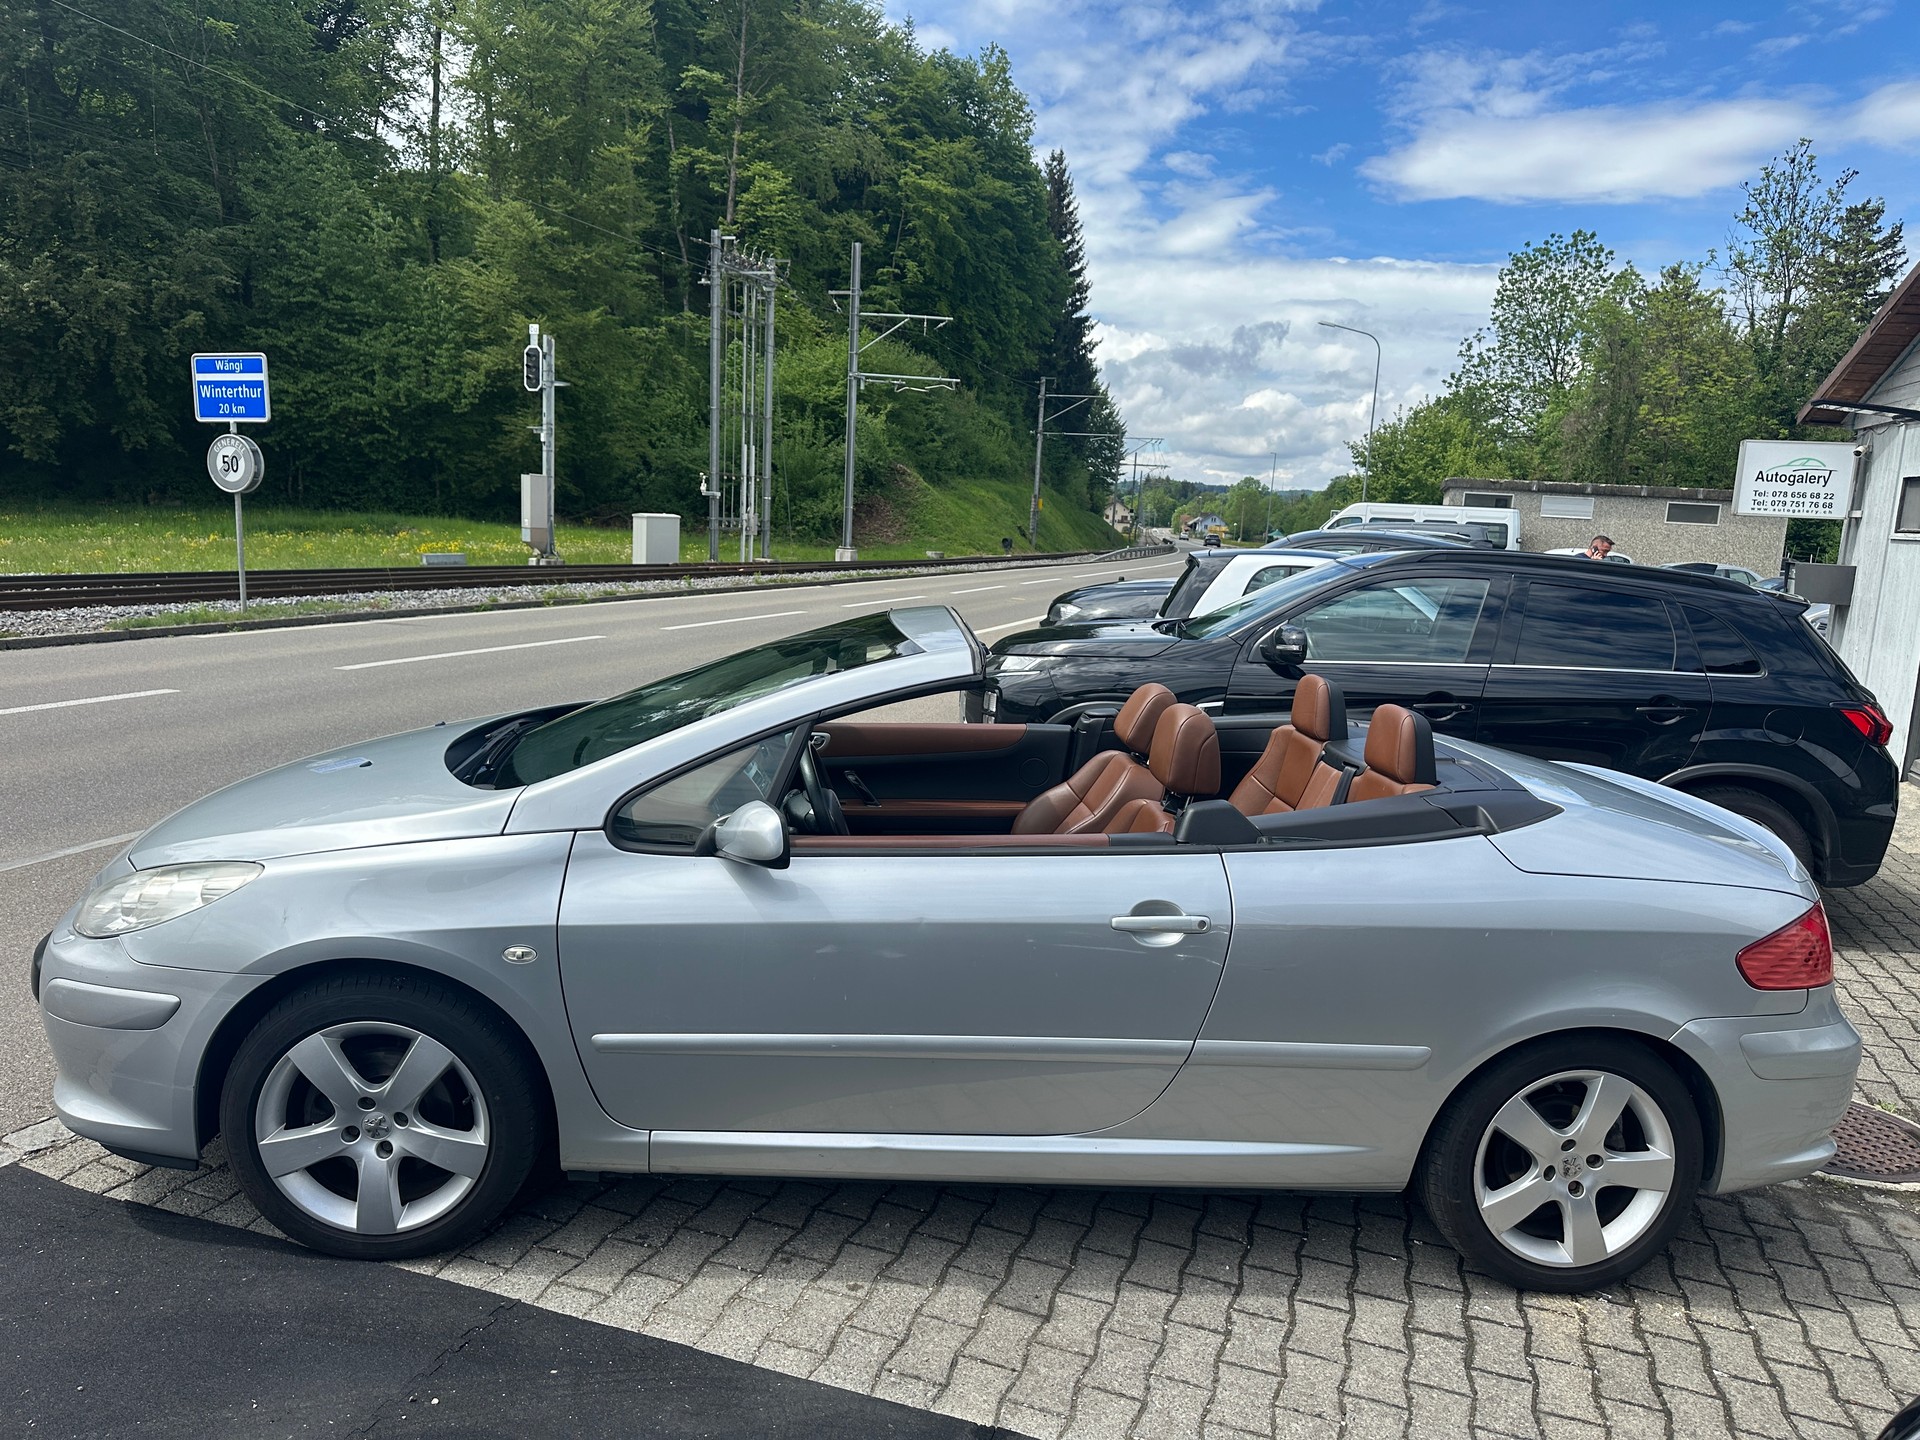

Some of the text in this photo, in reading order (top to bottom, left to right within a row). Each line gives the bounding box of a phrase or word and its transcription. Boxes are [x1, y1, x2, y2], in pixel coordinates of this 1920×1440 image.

[215, 358, 243, 373] Wängi
[199, 384, 262, 398] Winterthur
[218, 402, 246, 414] 20 km
[213, 438, 246, 454] GENERELL
[222, 454, 239, 473] 50
[1754, 469, 1835, 488] Autogalery
[1752, 489, 1835, 500] Tel: 078 656 68 22
[1751, 499, 1834, 509] Tel: 079 751 76 68
